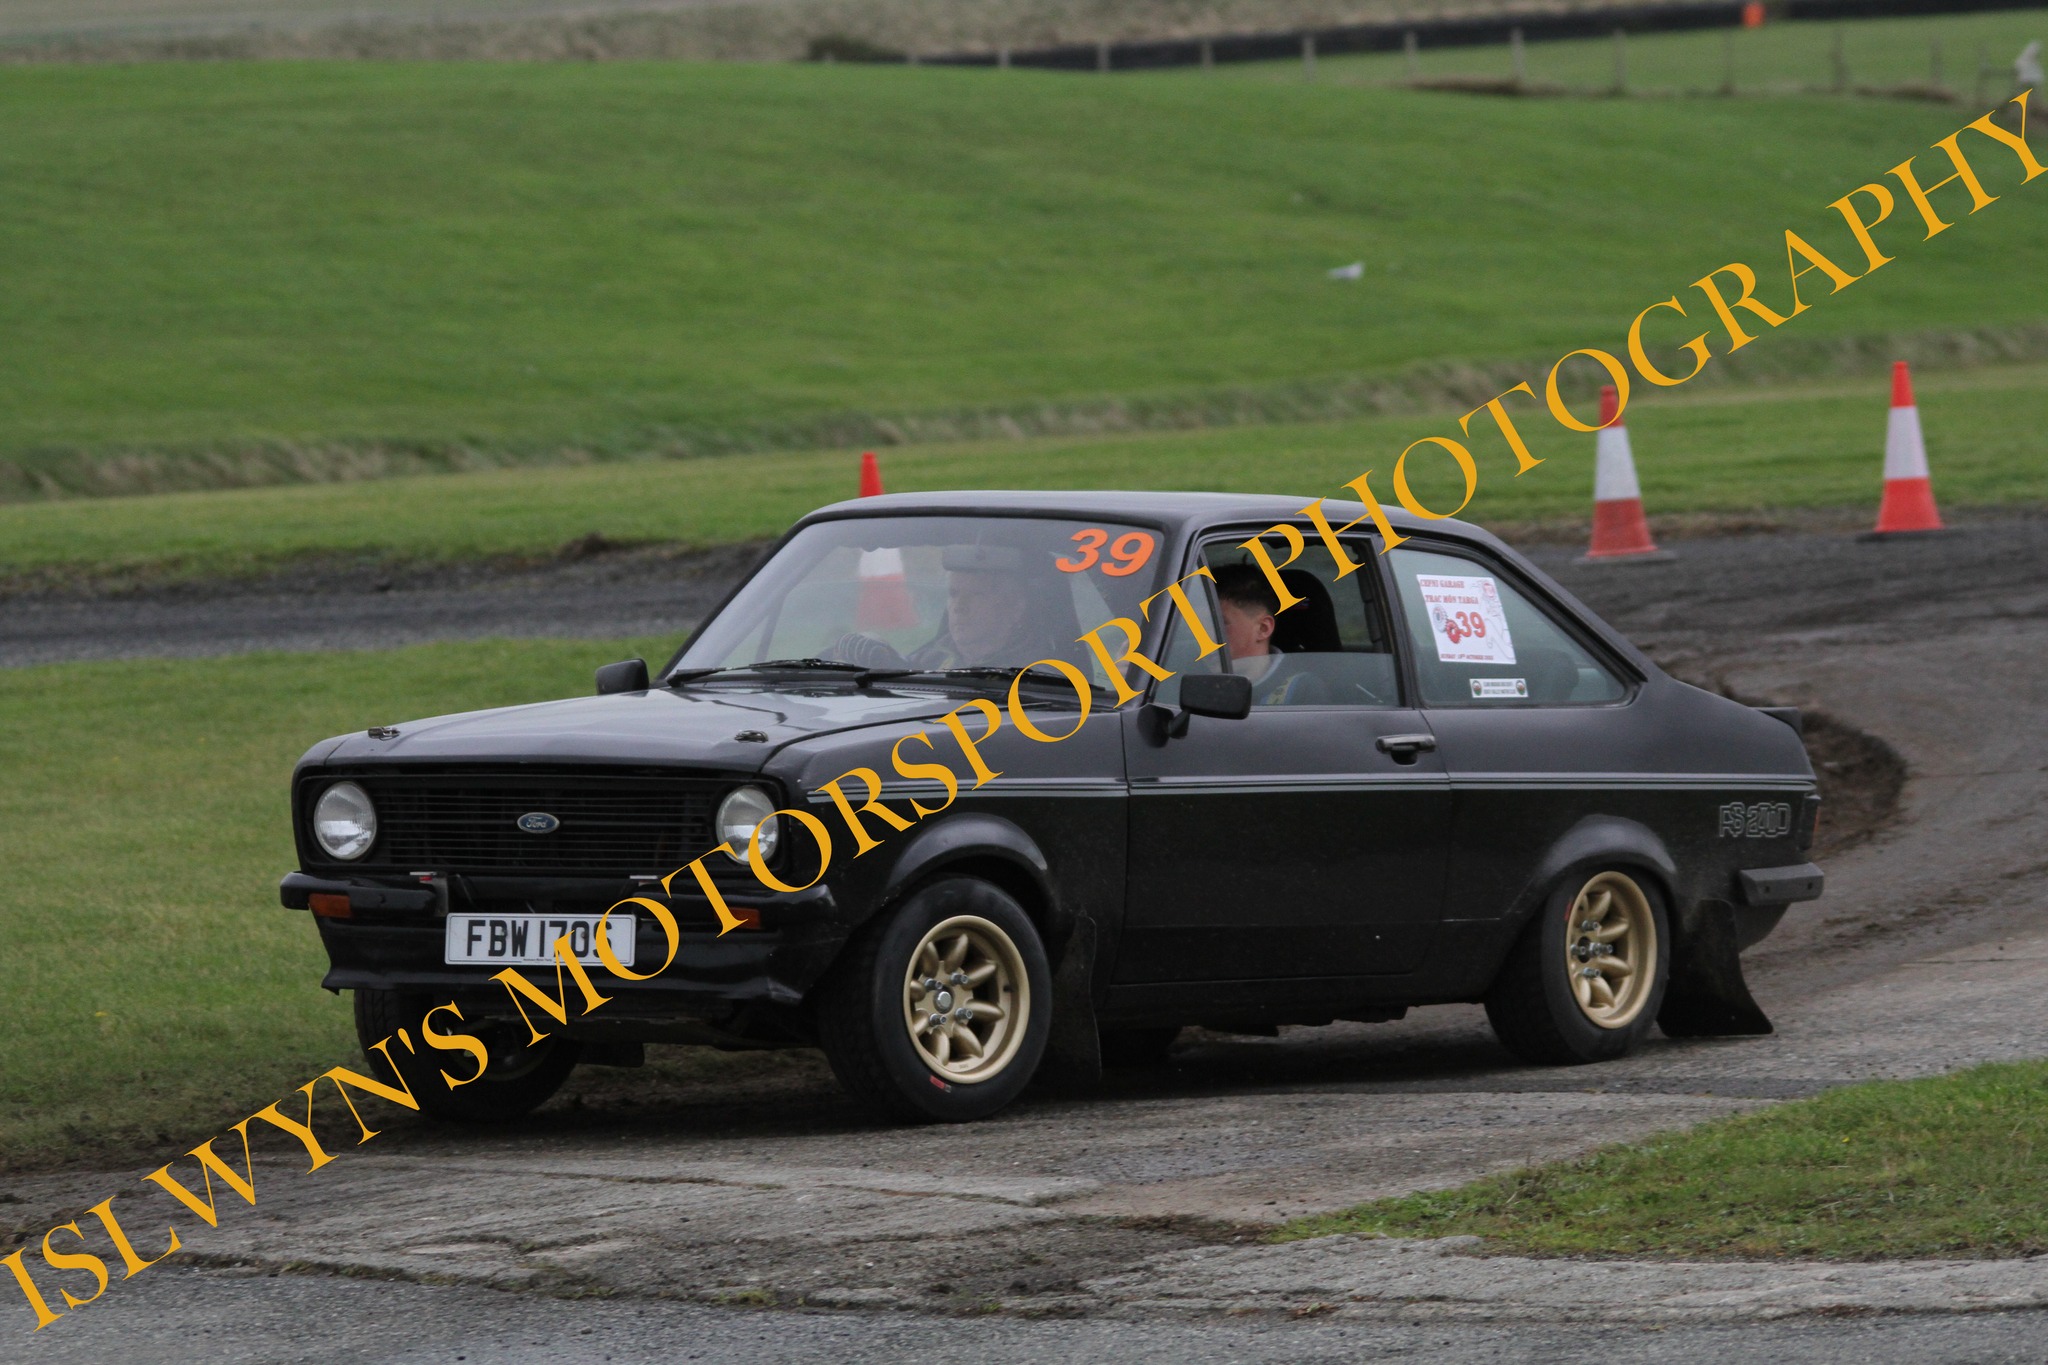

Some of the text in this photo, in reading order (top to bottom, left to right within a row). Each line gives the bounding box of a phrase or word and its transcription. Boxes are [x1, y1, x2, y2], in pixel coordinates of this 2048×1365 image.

[1055, 528, 1155, 577] 39
[1456, 611, 1486, 638] 39
[526, 816, 547, 828] Ford
[466, 919, 529, 958] FBW
